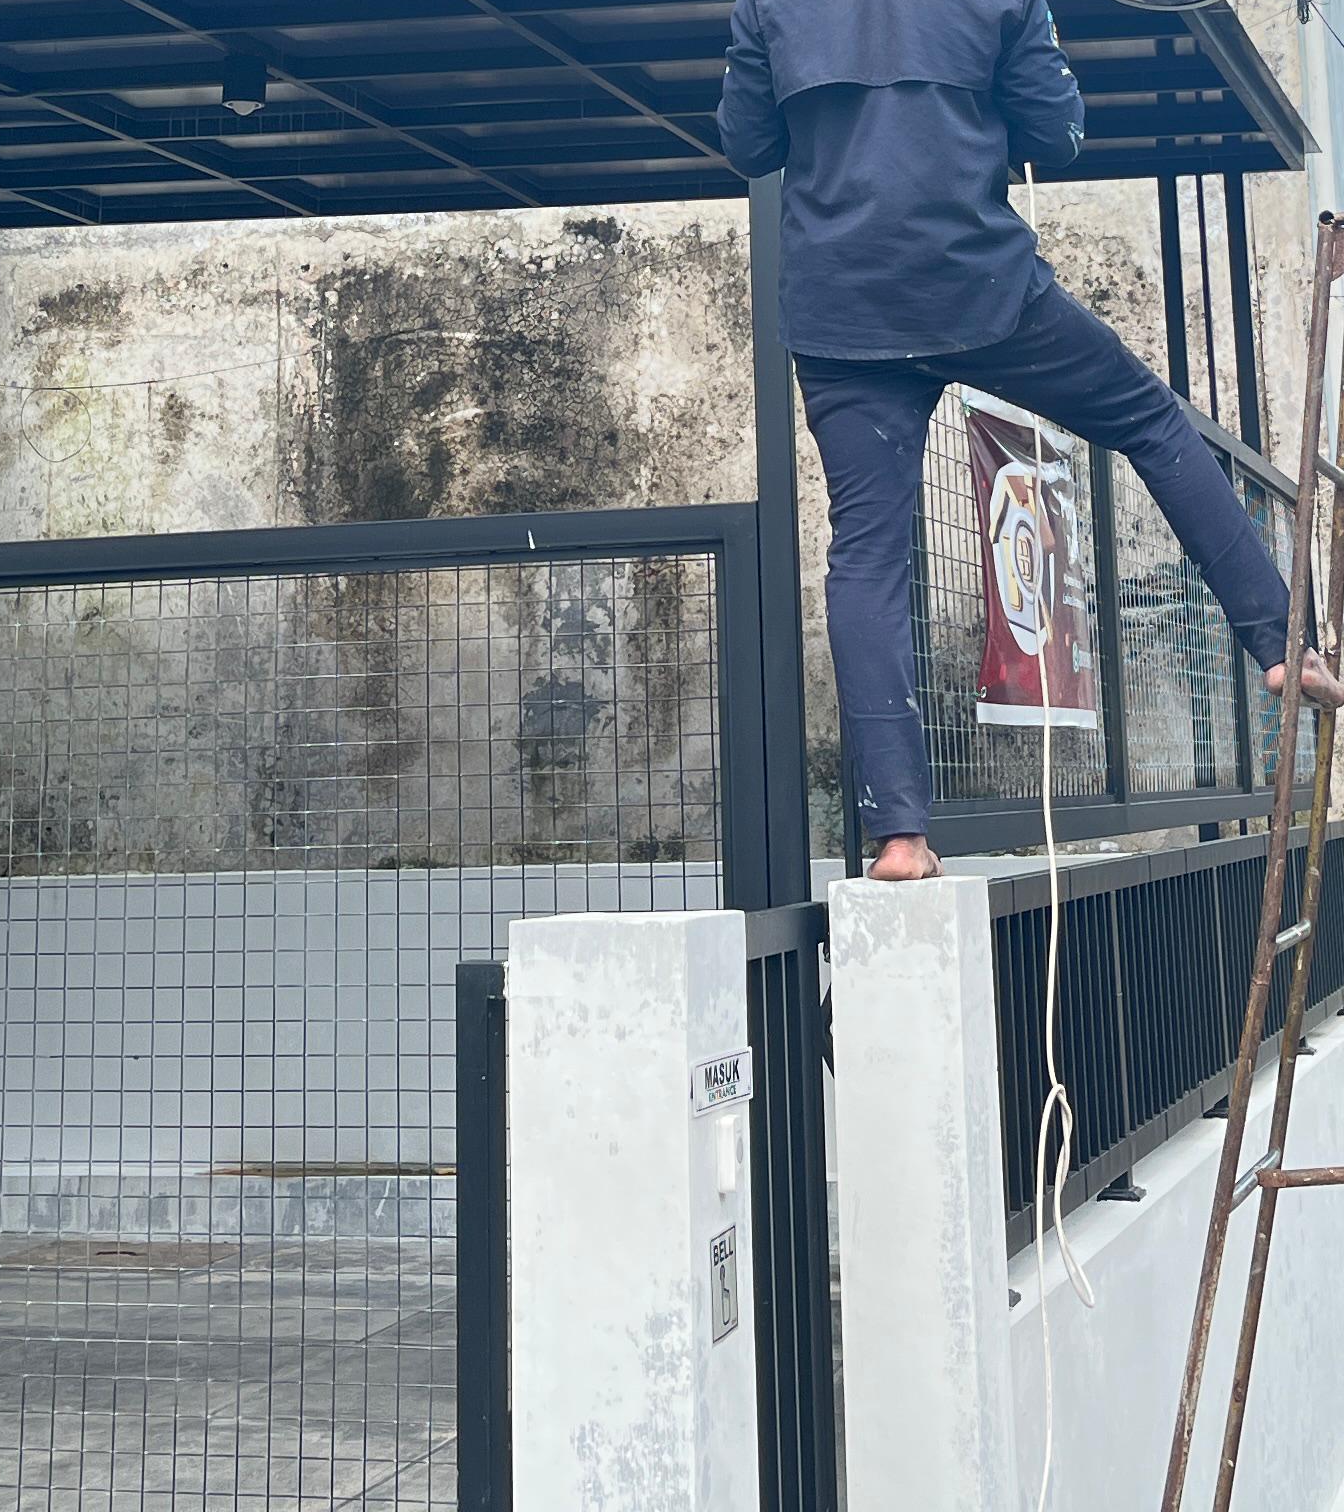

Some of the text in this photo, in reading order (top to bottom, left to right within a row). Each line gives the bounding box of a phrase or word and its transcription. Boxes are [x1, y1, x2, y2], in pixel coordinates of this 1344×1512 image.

[704, 1058, 740, 1089] MASUK
[708, 1084, 737, 1102] ENTRANCE
[713, 1235, 734, 1266] BELL
